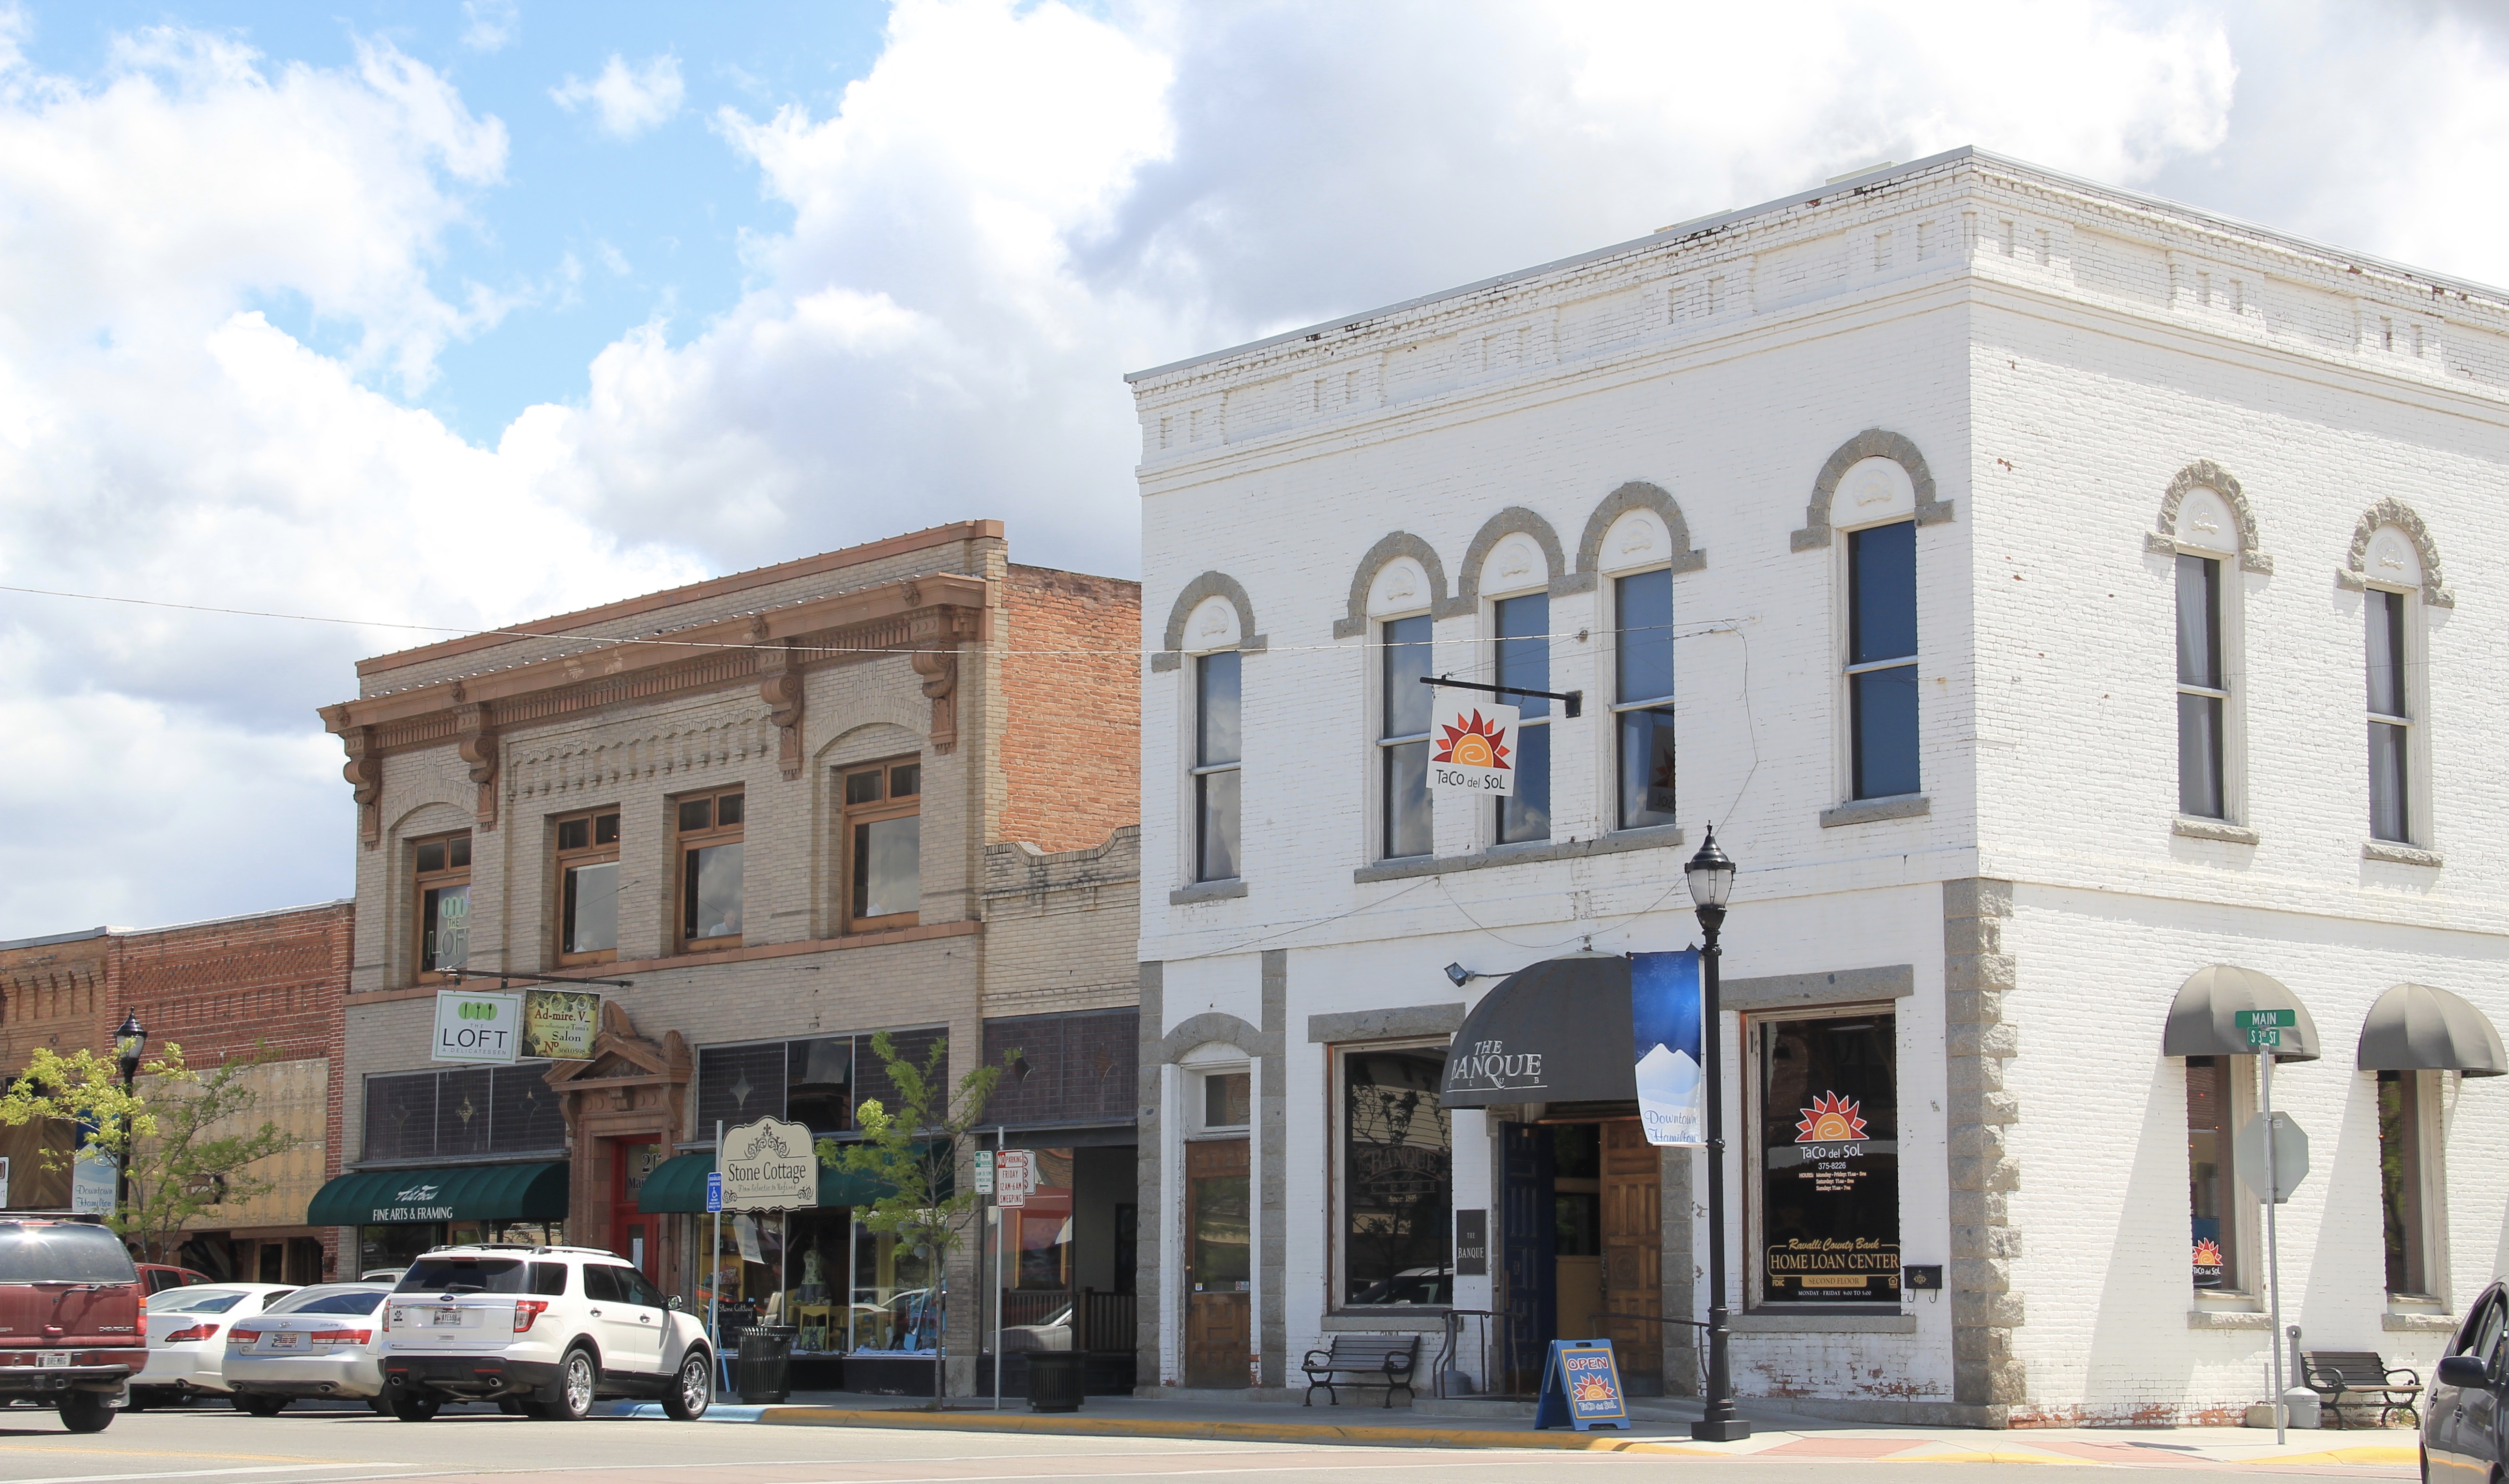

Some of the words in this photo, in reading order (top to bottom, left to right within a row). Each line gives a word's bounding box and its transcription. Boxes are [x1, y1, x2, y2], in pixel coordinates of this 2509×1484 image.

[1467, 777, 1480, 788] del
[448, 918, 459, 928] THE
[2252, 1012, 2276, 1025] MAIN
[443, 1028, 508, 1048] LOFT
[552, 1030, 581, 1042] Salon
[2251, 1030, 2255, 1043] S
[2269, 1031, 2276, 1044] ST
[1475, 1040, 1502, 1055] THE
[1644, 1109, 1696, 1124] Downtown
[1647, 1128, 1696, 1142] Hamilton
[1828, 1149, 1840, 1158] del
[998, 1155, 1004, 1166] NO
[1371, 1148, 1436, 1175] BANQUE
[728, 1163, 760, 1181] Stone
[763, 1162, 806, 1184] Cottage
[628, 1175, 647, 1189] Mai
[777, 1181, 796, 1194] Refined
[76, 1185, 112, 1195] Downtown
[76, 1197, 111, 1207] Hamilton
[1000, 1194, 1021, 1203] SWEEPING
[373, 1209, 389, 1221] FINE
[390, 1208, 408, 1220] ARTS
[410, 1208, 415, 1219] &
[417, 1207, 453, 1219] FRAMING
[1789, 1238, 1821, 1250] Ravalli
[1823, 1238, 1854, 1251] County
[1856, 1238, 1879, 1249] Bank
[1458, 1247, 1484, 1258] BANQUE
[1770, 1255, 1808, 1269] HOME
[1811, 1254, 1845, 1269] LOAN
[1848, 1254, 1899, 1269] CENTER
[719, 1303, 733, 1312] Stone
[734, 1303, 753, 1318] Cottage
[1567, 1357, 1608, 1370] OPEN
